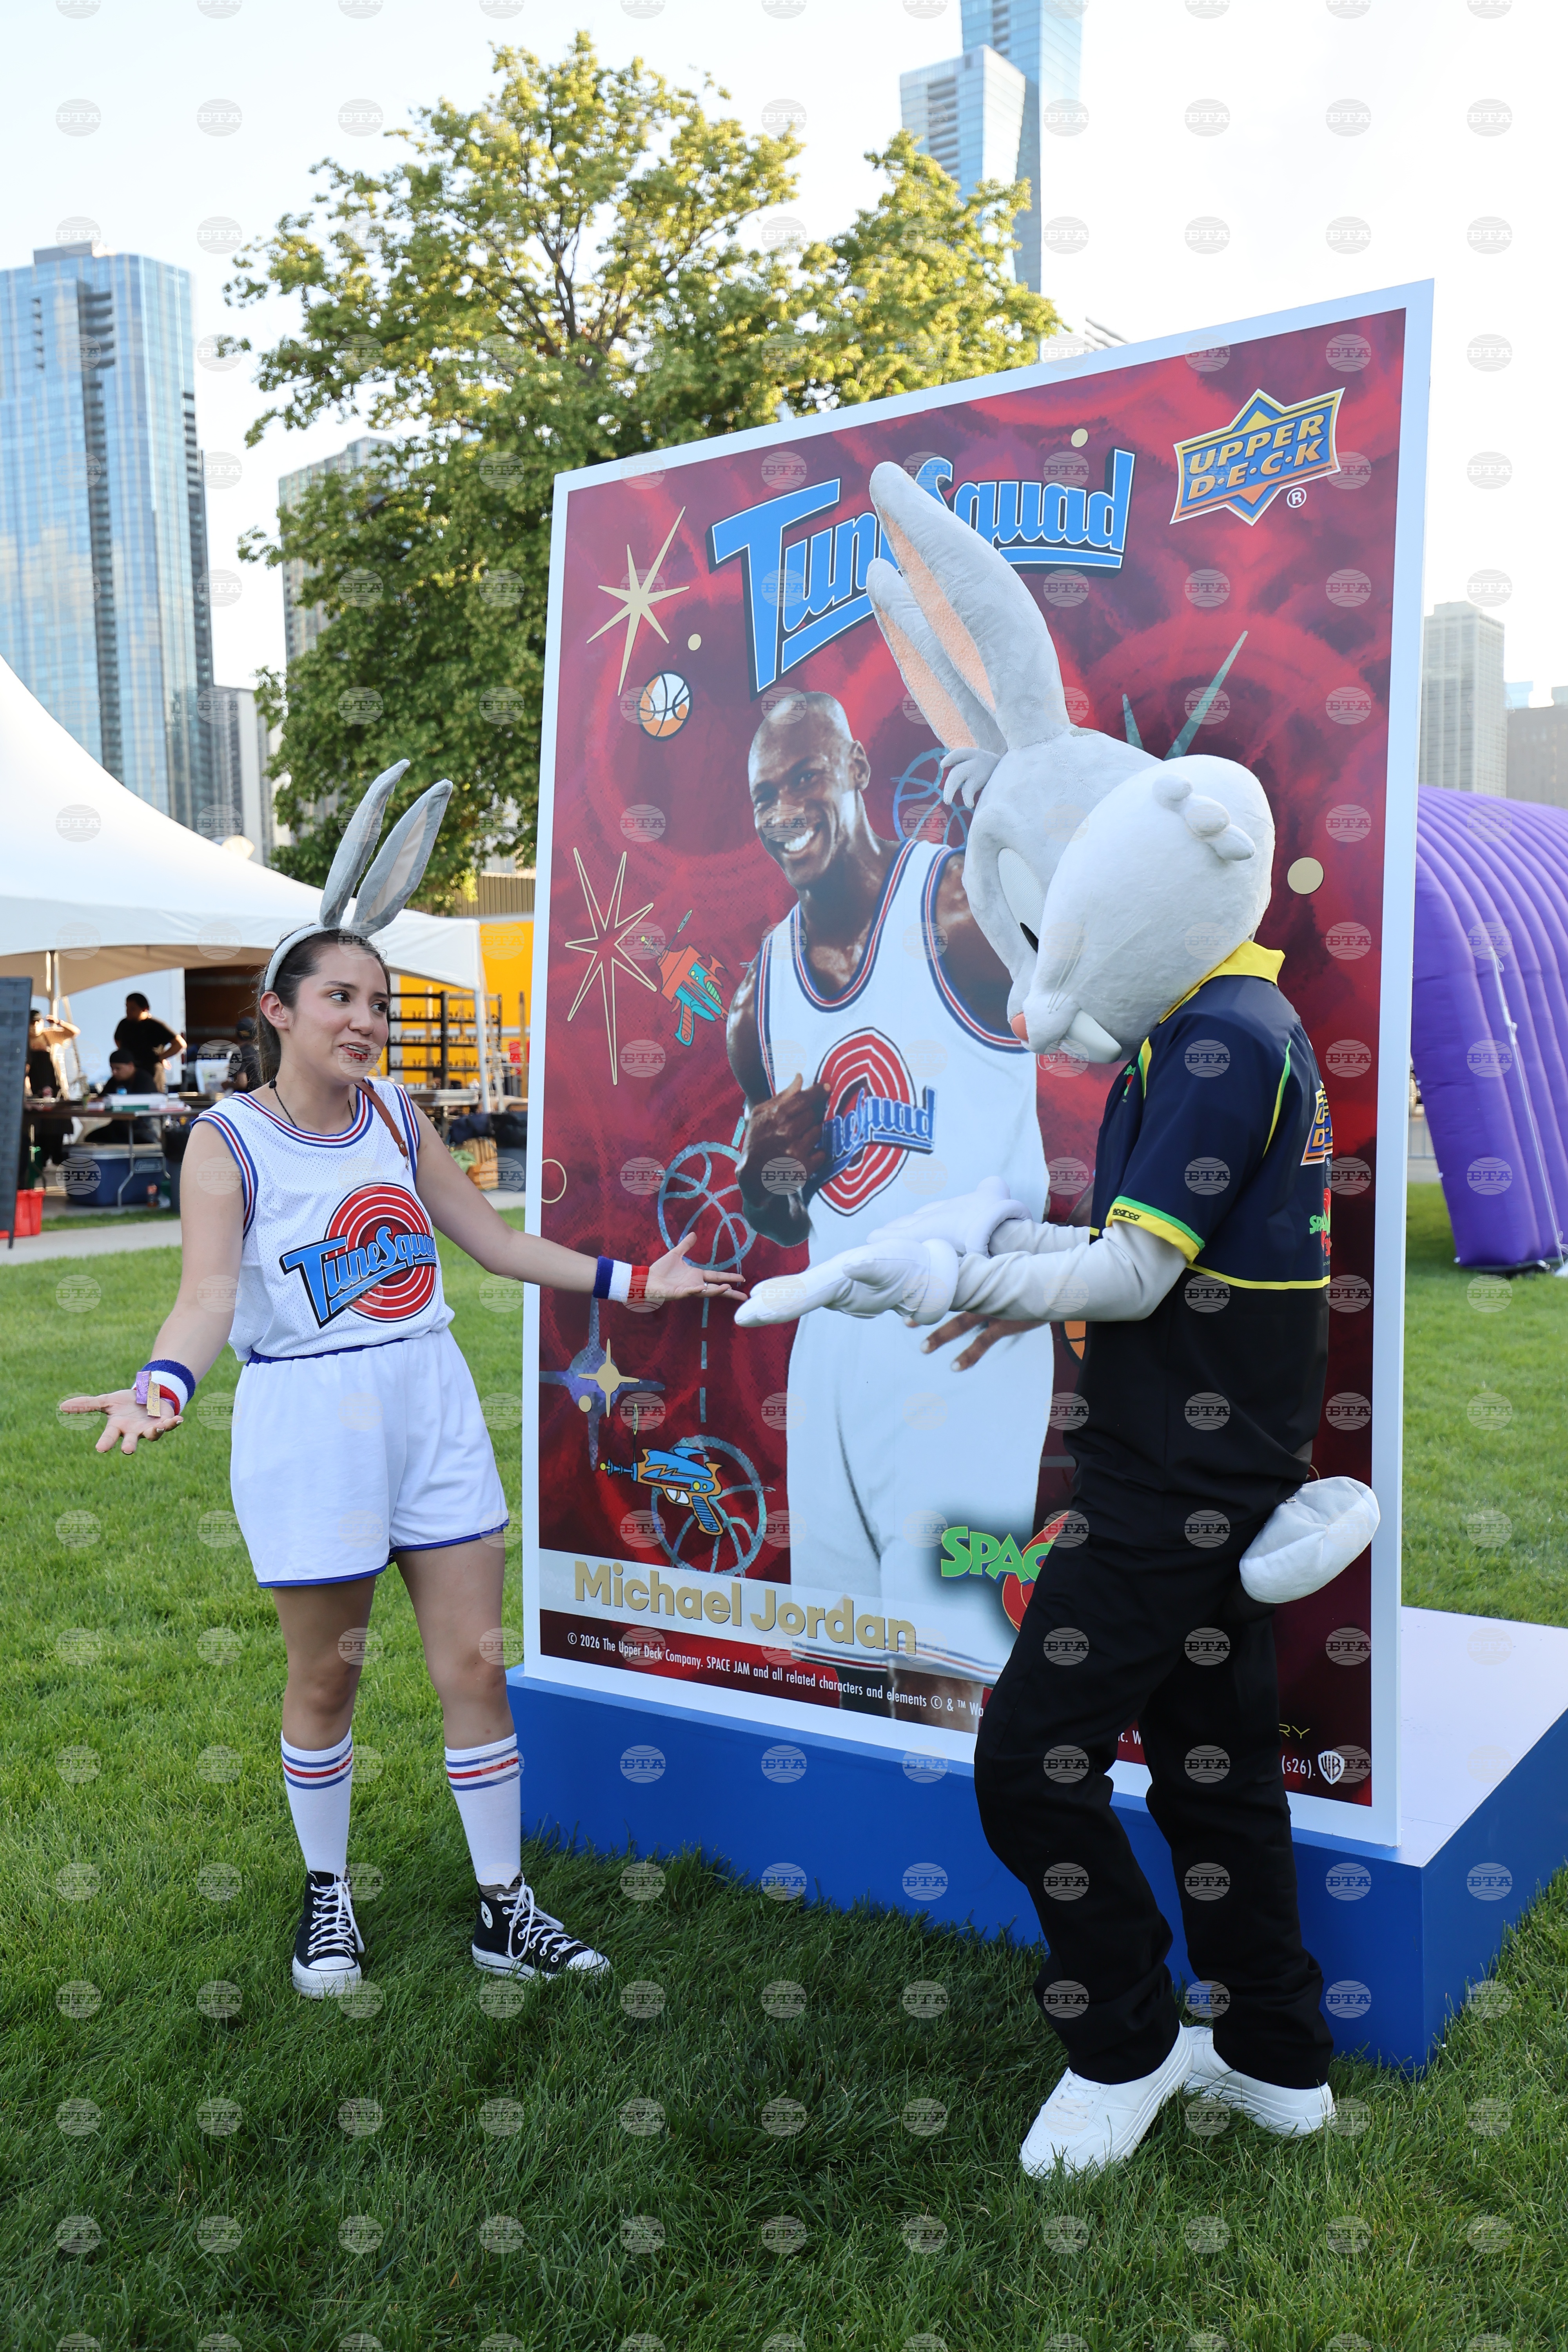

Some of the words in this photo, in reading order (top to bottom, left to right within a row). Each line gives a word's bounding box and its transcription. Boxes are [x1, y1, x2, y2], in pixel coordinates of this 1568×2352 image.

[1189, 414, 1325, 474] UPPER
[1112, 1208, 1140, 1220] sparco
[941, 1526, 1054, 1584] SPAC
[575, 1561, 742, 1626] Michael
[750, 1589, 916, 1655] Jordan
[580, 1634, 600, 1649] 2026
[603, 1638, 616, 1651] The
[619, 1641, 641, 1657] Upper
[644, 1645, 662, 1660] Deck
[665, 1649, 704, 1670] Company.
[706, 1656, 731, 1672] SPACE
[733, 1661, 750, 1676] JAM
[753, 1665, 769, 1679] and
[772, 1667, 783, 1681] all
[786, 1670, 816, 1687] related
[819, 1675, 863, 1695] characters
[866, 1685, 883, 1699] and
[886, 1687, 927, 1707] elements
[947, 1698, 954, 1712] &
[1281, 1755, 1316, 1779] (s26).
